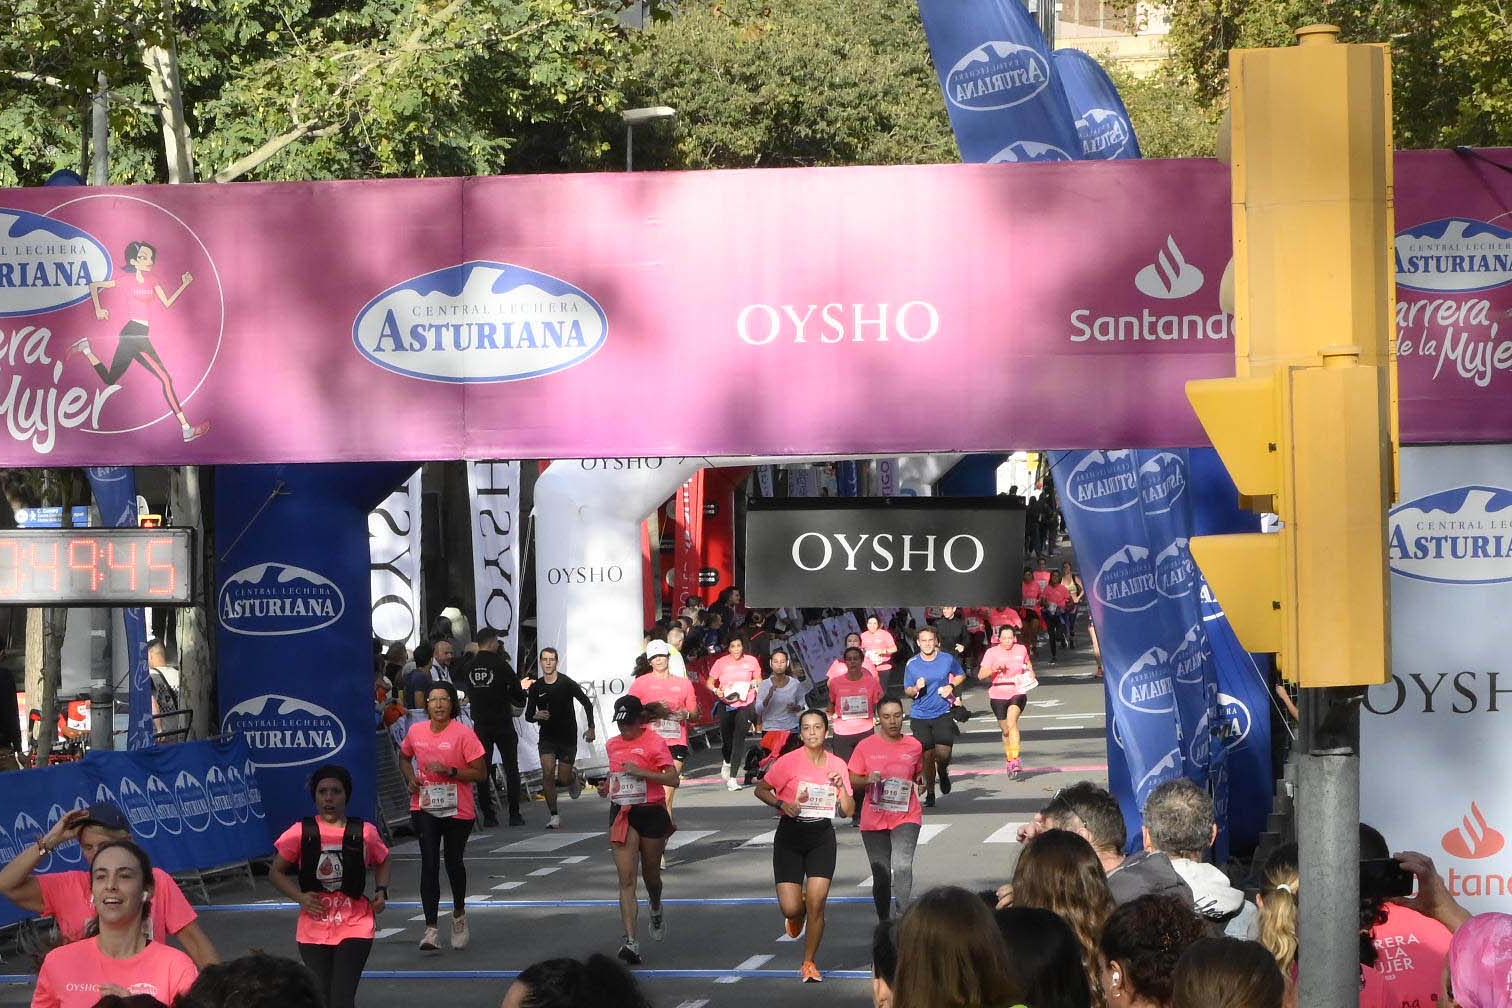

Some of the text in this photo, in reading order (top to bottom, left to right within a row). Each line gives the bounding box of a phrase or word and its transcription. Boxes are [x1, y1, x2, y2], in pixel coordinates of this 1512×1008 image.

[14, 243, 88, 256] LECHERA
[1465, 241, 1512, 251] LECHER
[1395, 246, 1512, 274] ASTURIAN
[412, 301, 579, 317] CENTRAL LECHERA
[1396, 298, 1491, 327] arrera
[372, 308, 588, 354] ASTURIANA
[737, 300, 940, 345] OYSHO
[1069, 308, 1234, 343] Santand
[1419, 328, 1436, 356] la
[1432, 321, 1512, 388] Muje
[580, 457, 662, 471] OYSHO
[1416, 520, 1484, 531] CENTRAL
[791, 531, 985, 573] OYSHO
[547, 565, 623, 585] OYSHO
[235, 586, 331, 595] CENTRAL LECHERA
[222, 591, 335, 619] ASTURIANA
[474, 672, 488, 681] BP
[580, 678, 625, 696] SHO
[236, 718, 332, 728] CENTRAL LECHERA
[226, 723, 337, 750] TURIANA
[1374, 932, 1421, 950] RERA
[1384, 947, 1407, 961] LA
